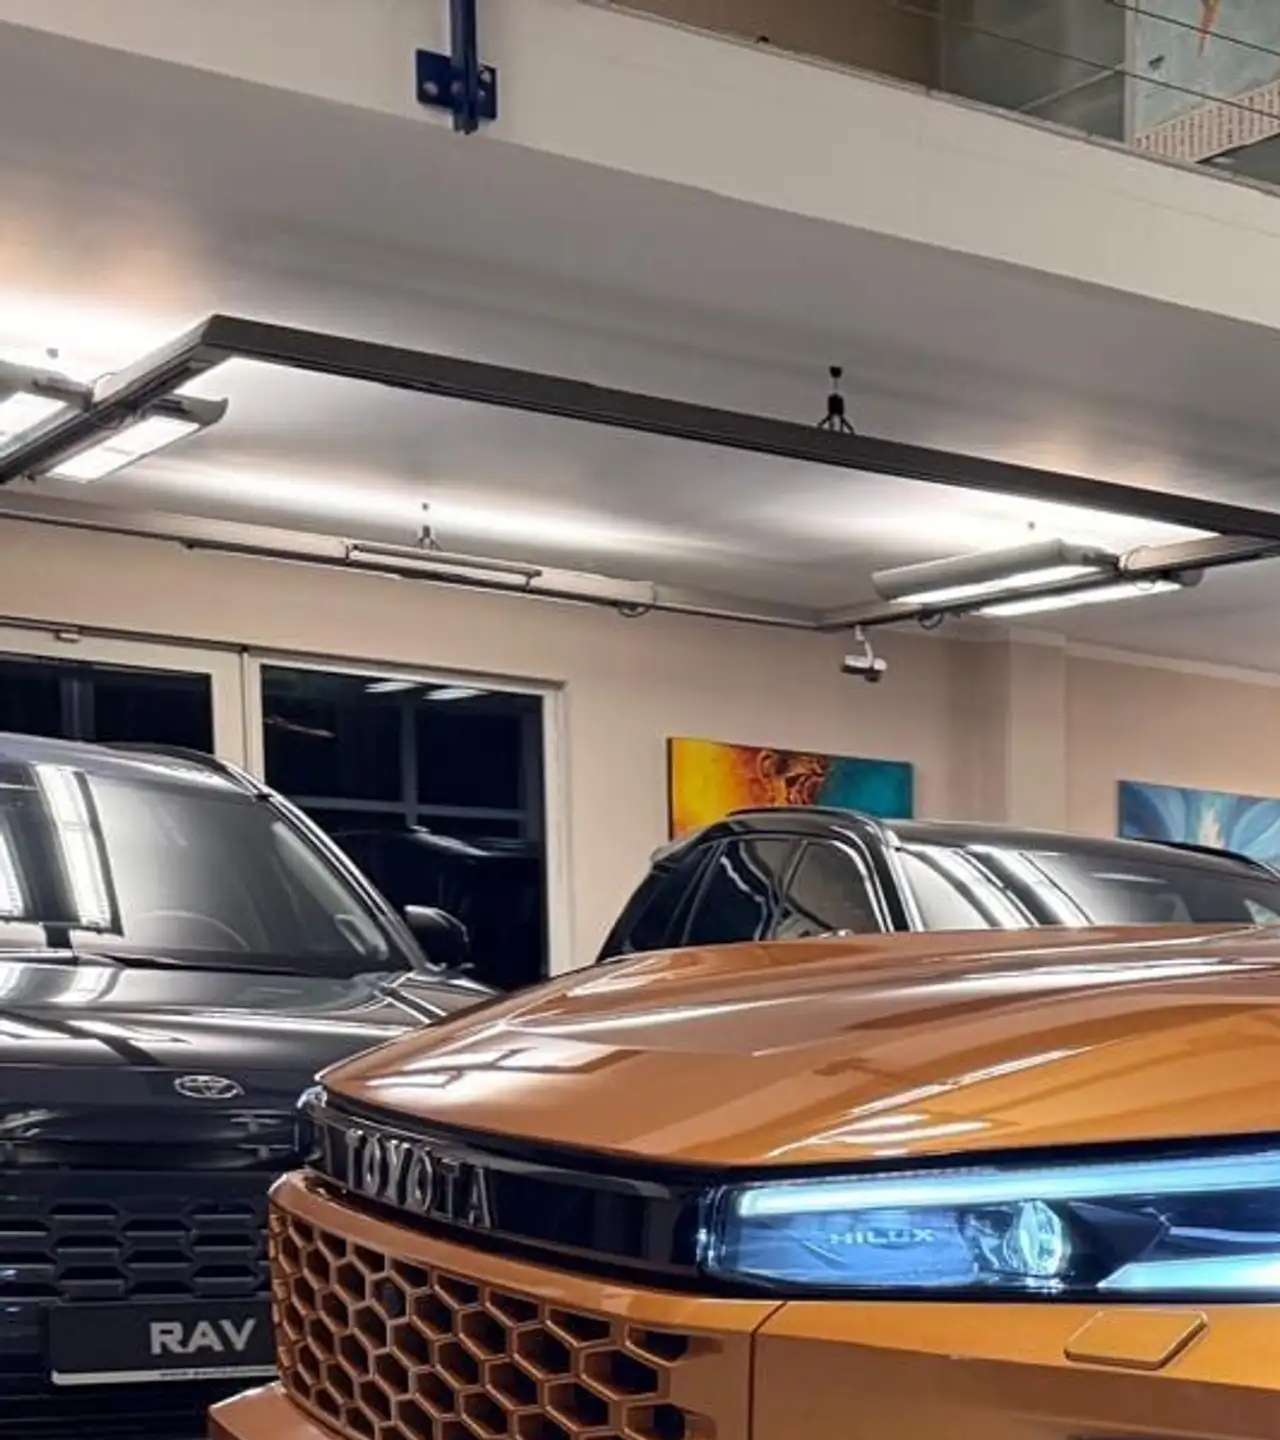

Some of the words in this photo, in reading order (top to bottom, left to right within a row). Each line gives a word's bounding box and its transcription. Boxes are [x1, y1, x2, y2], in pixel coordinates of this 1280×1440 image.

[345, 1128, 492, 1230] TOYOTA
[829, 1228, 935, 1244] HILUX
[150, 1317, 257, 1355] RAV
